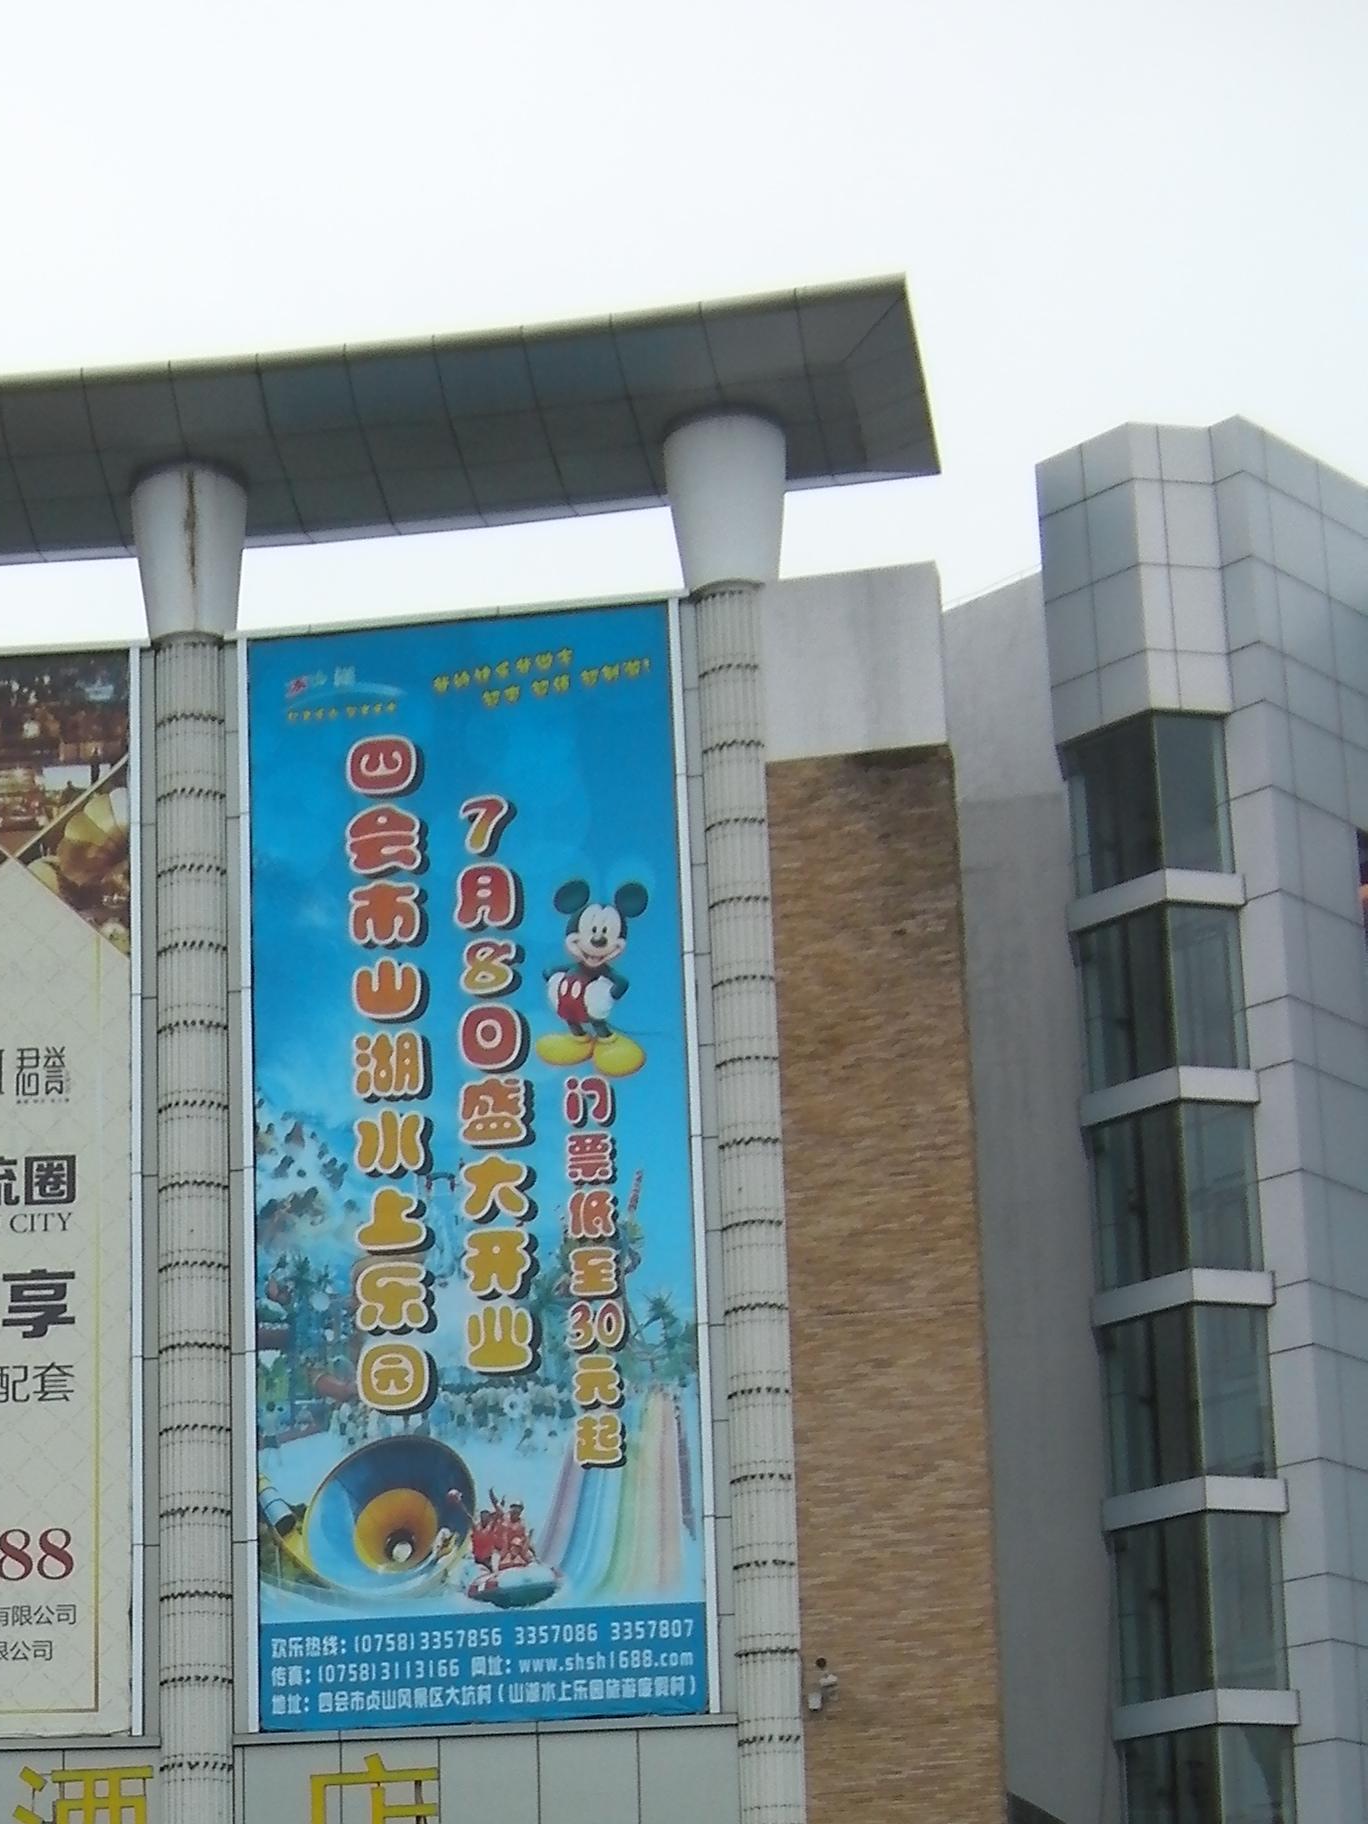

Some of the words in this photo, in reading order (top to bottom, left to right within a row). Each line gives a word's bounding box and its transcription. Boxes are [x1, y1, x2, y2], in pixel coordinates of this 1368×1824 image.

[9, 1211, 74, 1234] CITY
[515, 1623, 598, 1646] 3357086
[610, 1618, 694, 1641] 3357807
